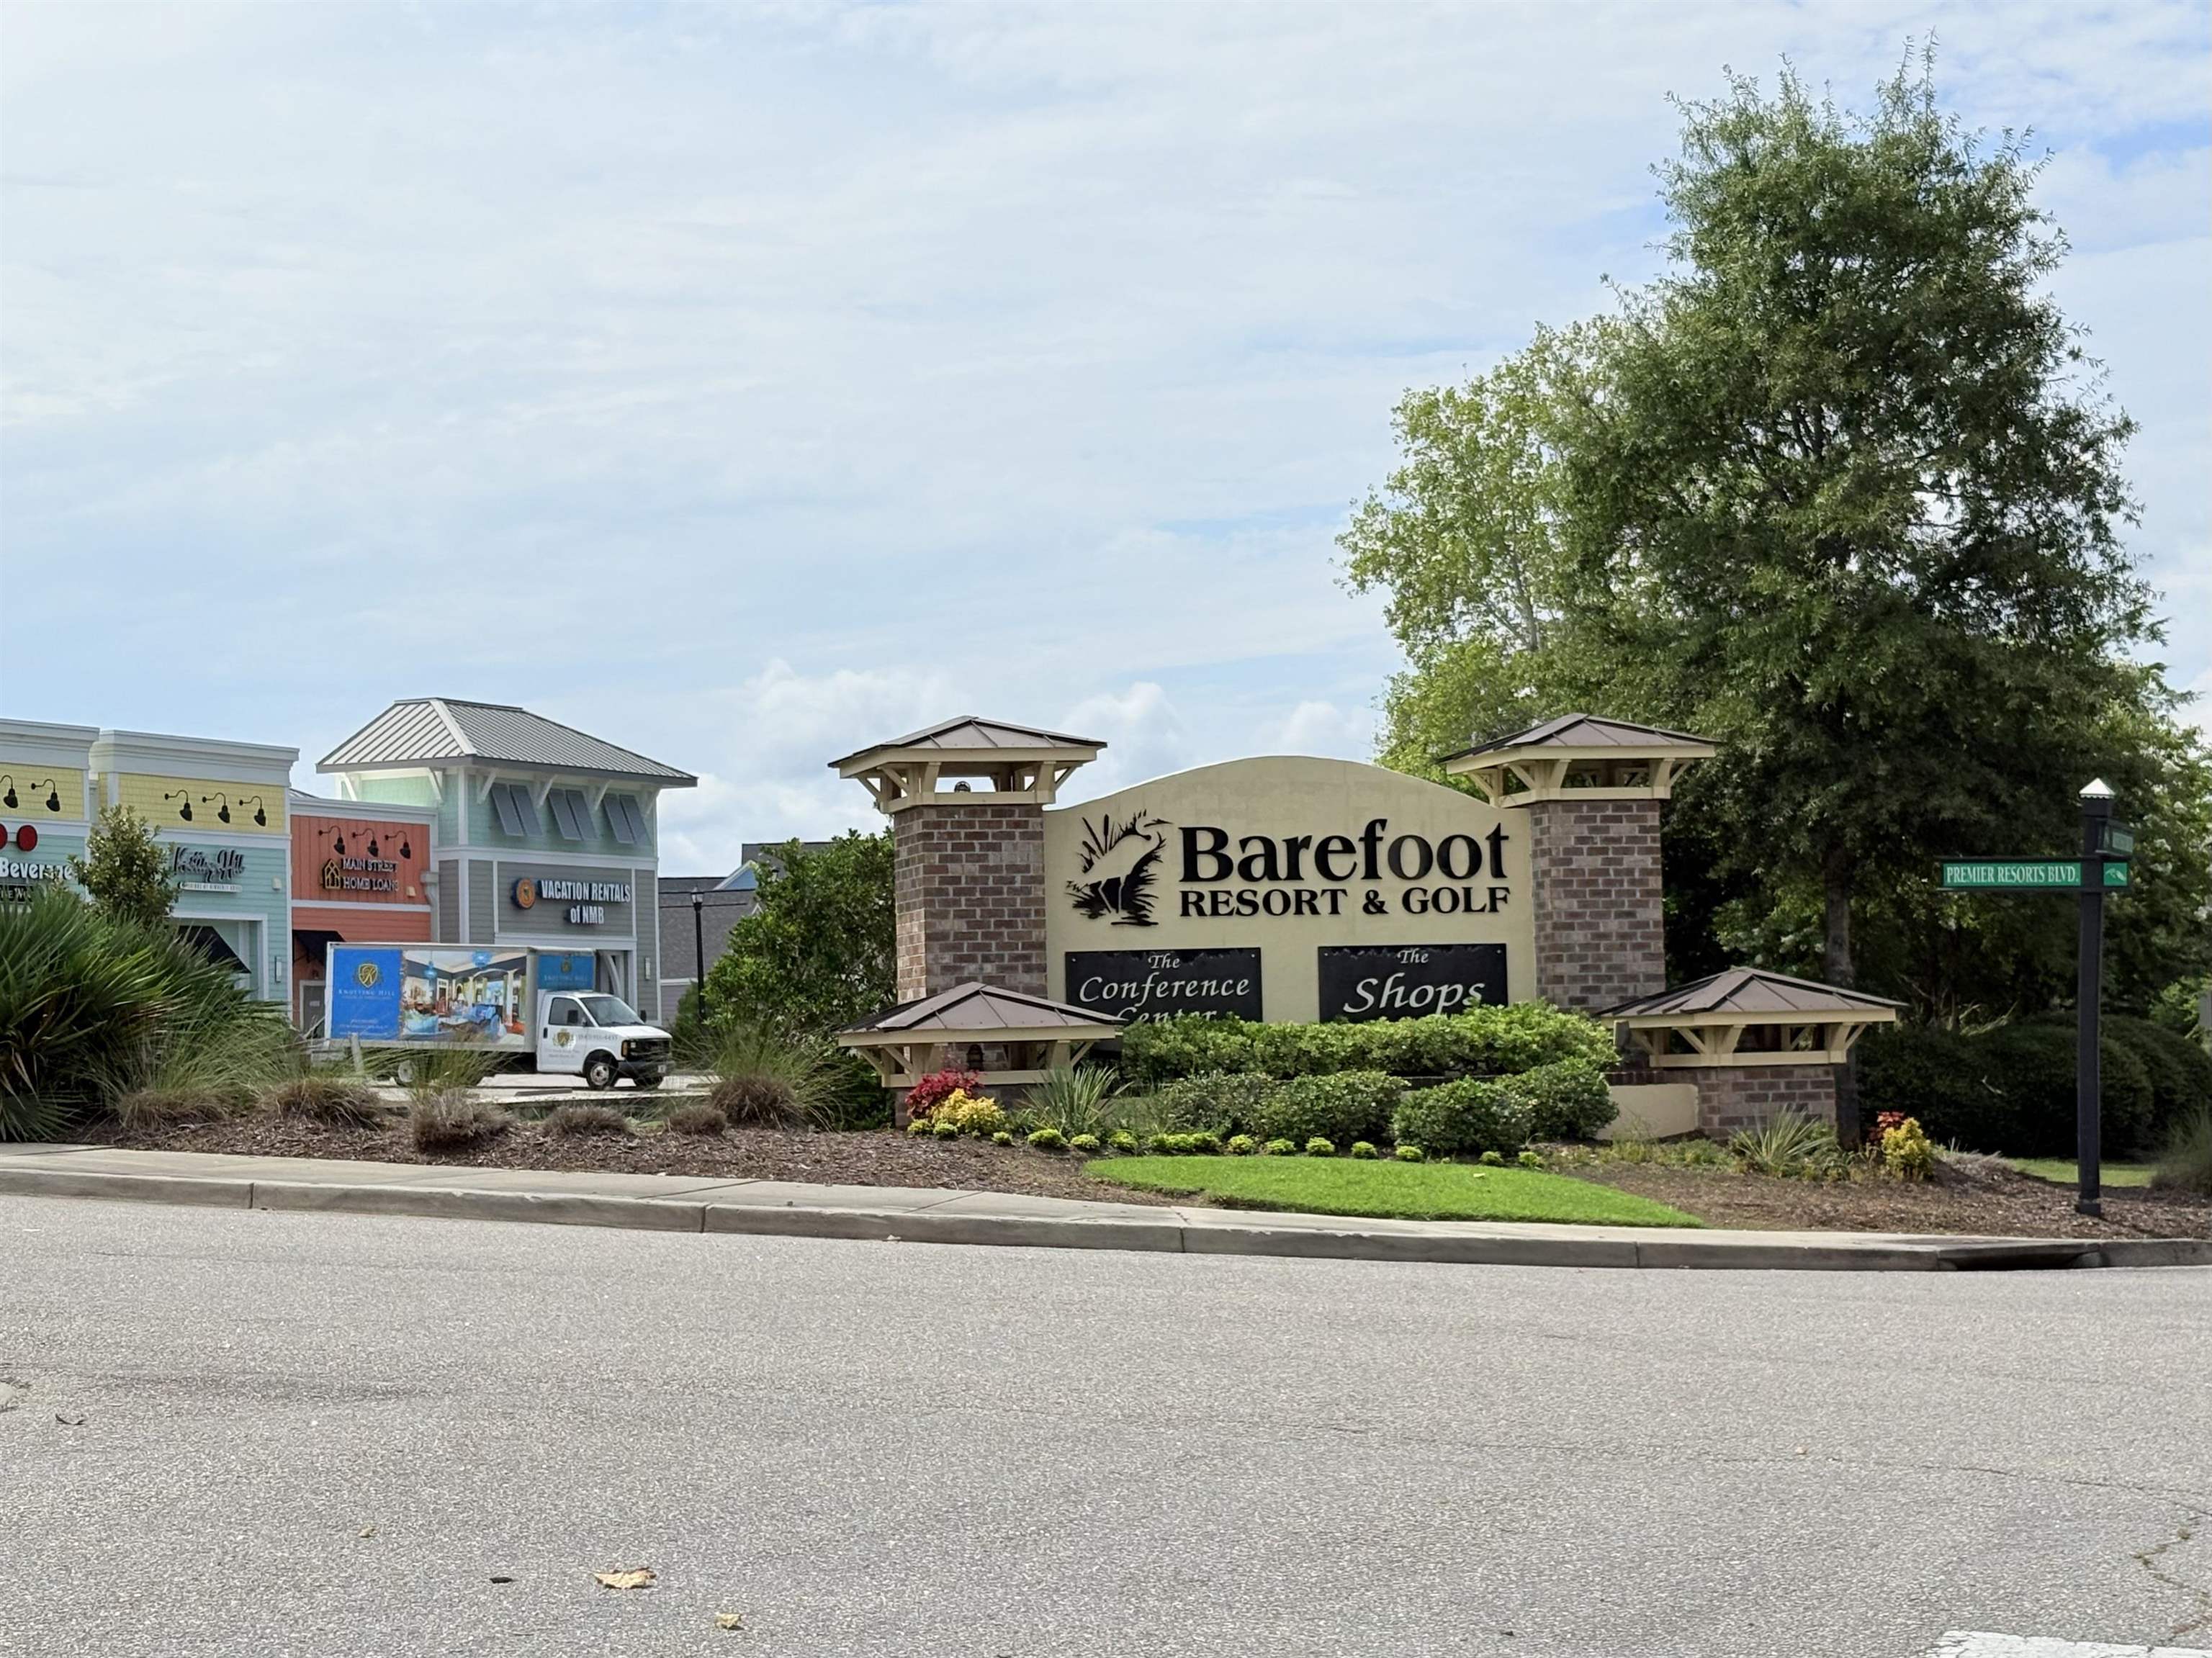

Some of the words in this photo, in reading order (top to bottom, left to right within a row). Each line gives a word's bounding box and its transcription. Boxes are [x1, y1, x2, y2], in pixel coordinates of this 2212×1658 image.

[1179, 819, 1510, 883] Barefoot
[342, 857, 366, 871] MAIN
[367, 859, 398, 873] STREET
[1946, 866, 1995, 883] PREMIER
[1997, 866, 2045, 883] RESORTS
[2048, 865, 2080, 883] BLVD.
[343, 876, 371, 891] HOME
[541, 879, 590, 901] VACATION
[591, 883, 631, 902] RENTALS
[1179, 888, 1348, 916] RESORT
[1362, 889, 1389, 915] &
[1402, 886, 1511, 914] GOLF
[570, 905, 581, 924] of
[582, 906, 605, 924] NMB
[1148, 953, 1180, 969] The
[1397, 948, 1429, 964] The
[1079, 972, 1250, 1008] Conference
